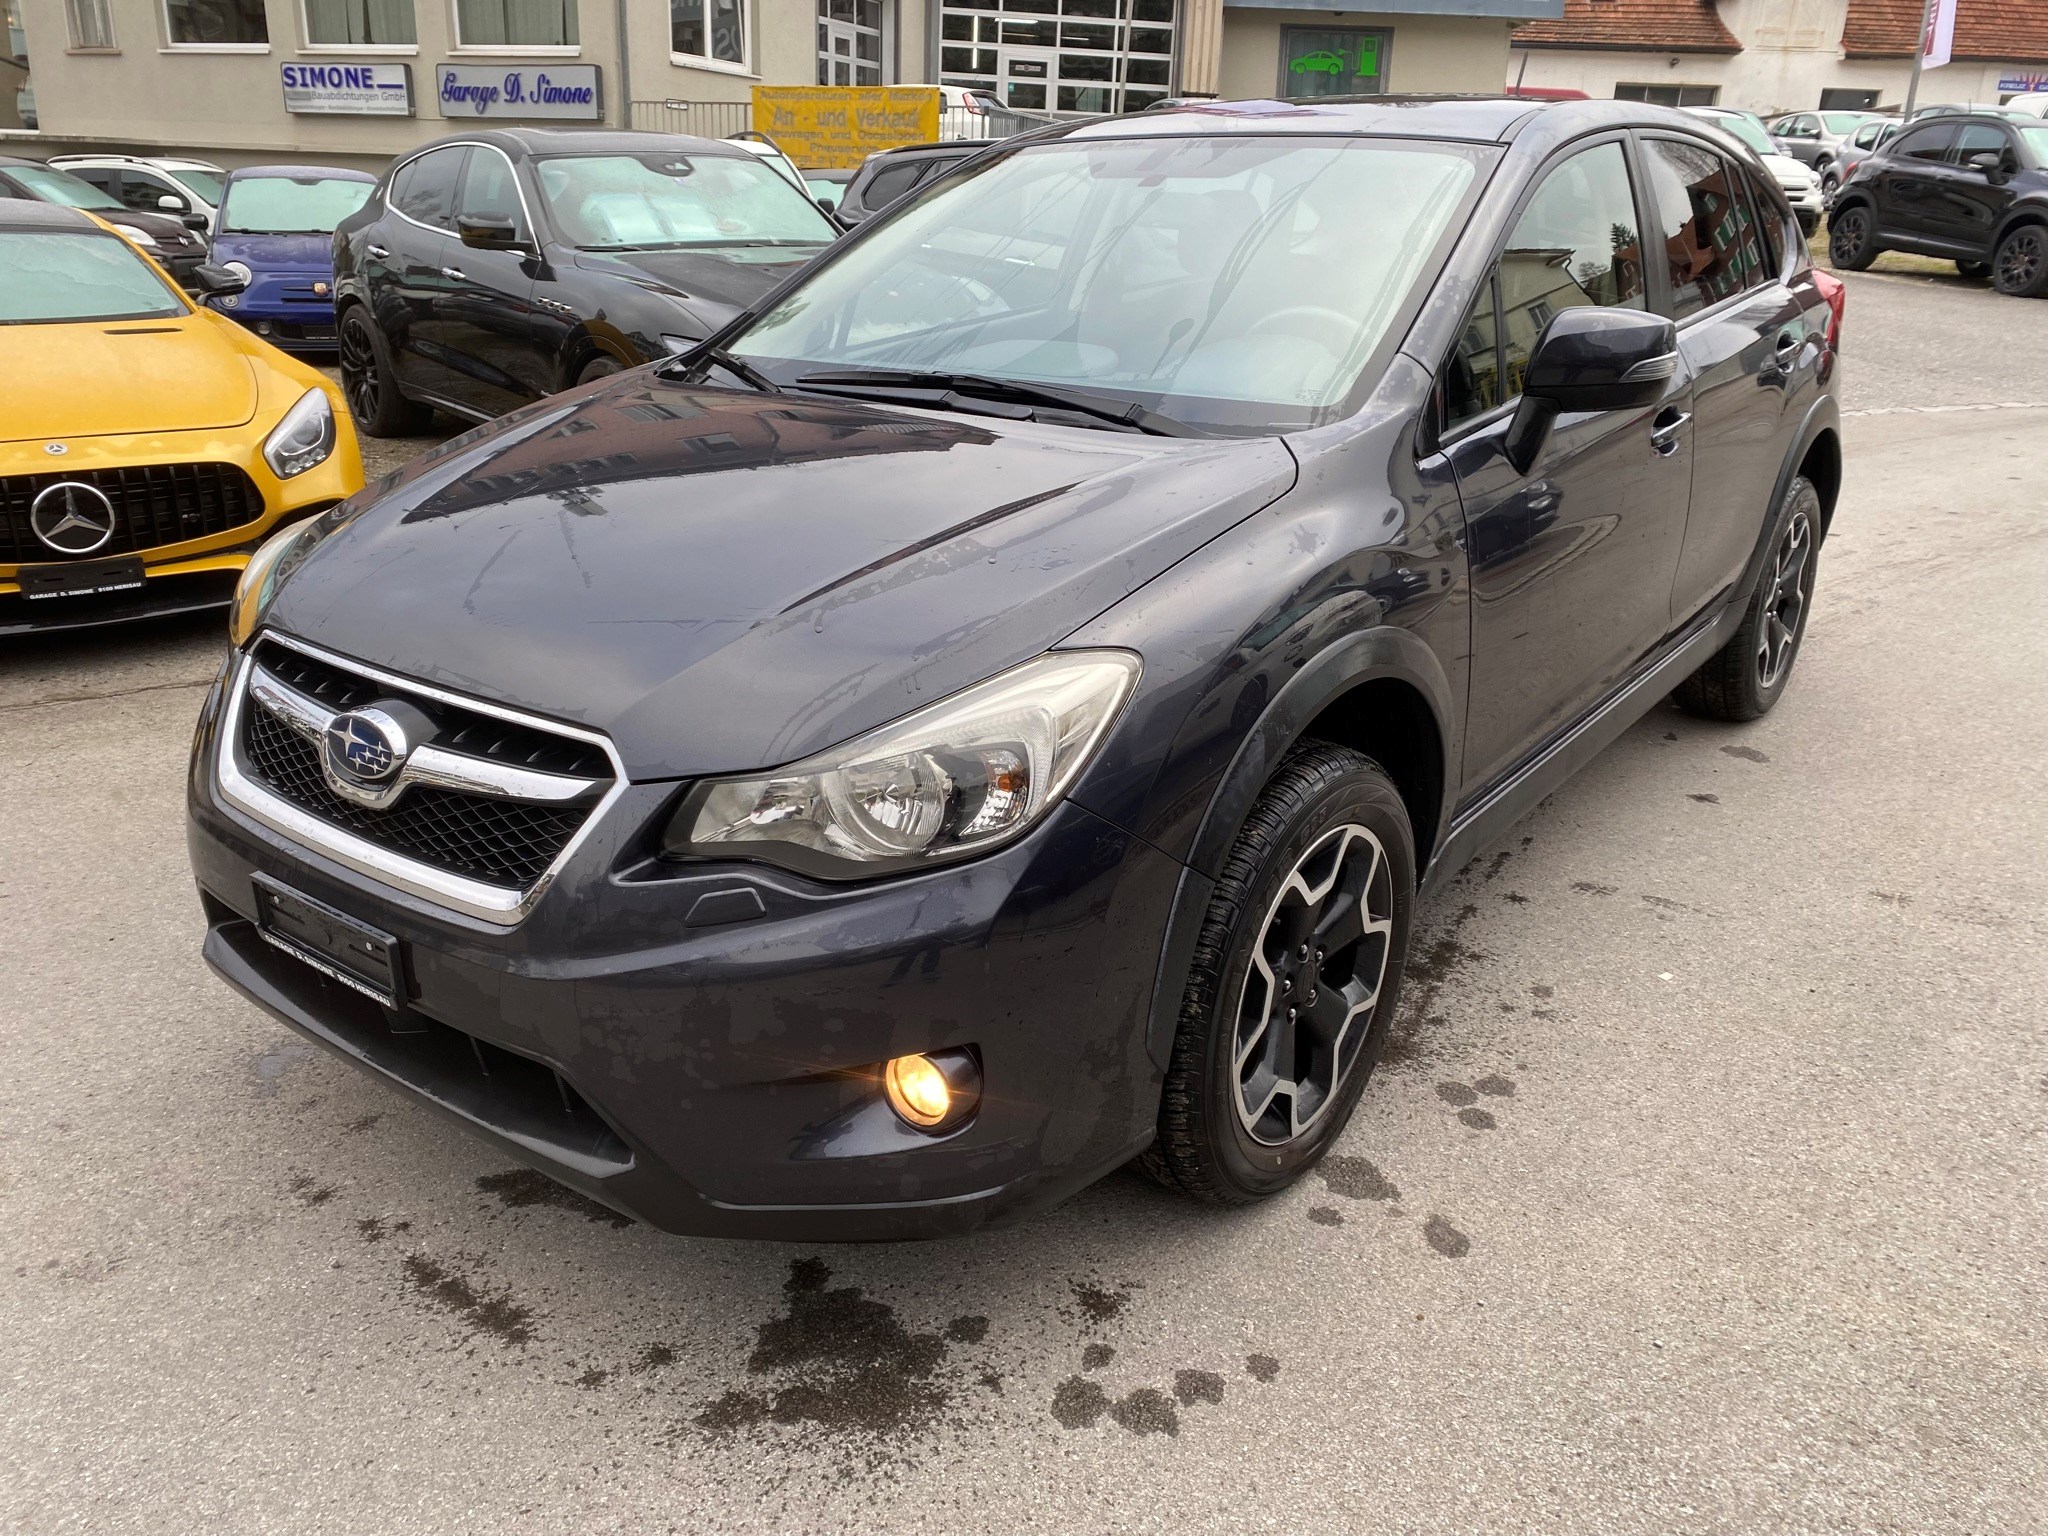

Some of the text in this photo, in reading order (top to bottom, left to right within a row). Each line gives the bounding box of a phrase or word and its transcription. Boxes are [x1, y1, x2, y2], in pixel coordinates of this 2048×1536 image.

[283, 66, 374, 89] SIMONE
[311, 91, 406, 102] Bauabdichtungen GmbH
[441, 71, 592, 114] Garage D. Simone
[759, 90, 851, 101] Autoreparaturen
[859, 91, 882, 101] aller
[773, 106, 794, 127] An
[816, 108, 847, 128] und
[855, 107, 920, 129] Verkauf
[765, 129, 926, 141] Neuwagen und Occasionen
[68, 588, 94, 596] SIMONE
